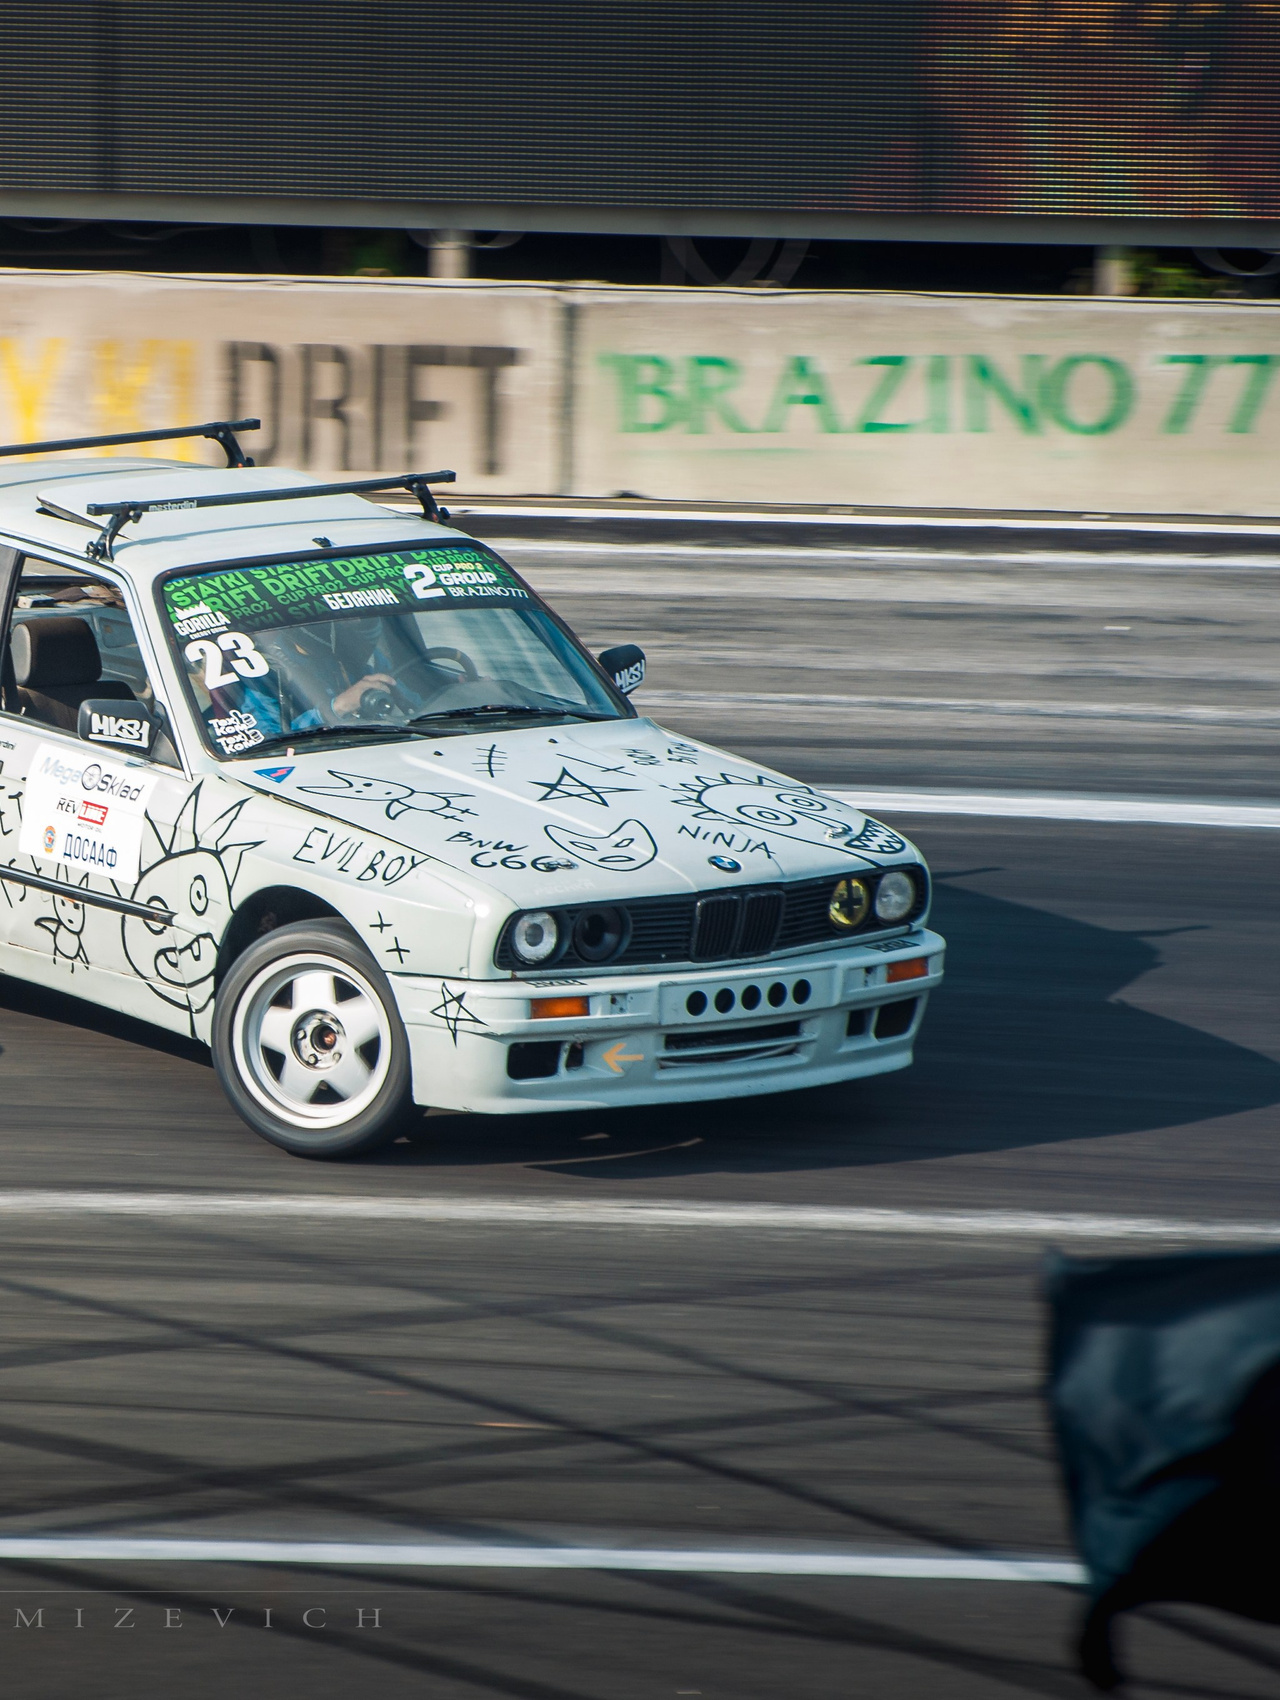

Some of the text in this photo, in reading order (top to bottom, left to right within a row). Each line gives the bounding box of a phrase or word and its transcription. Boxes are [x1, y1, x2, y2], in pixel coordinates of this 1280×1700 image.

[223, 340, 530, 476] DRIFT
[598, 353, 1140, 436] BRAZINO
[264, 564, 335, 597] DRIFT
[403, 563, 446, 599] 2
[432, 563, 453, 572] CUP
[454, 562, 475, 571] PRO
[438, 571, 498, 586] GROUP
[171, 571, 249, 607] STAYKI
[277, 588, 310, 605] CUP
[310, 579, 347, 597] PRO2
[347, 572, 377, 586] CUP
[322, 588, 400, 610] БЕЛЯНИН
[447, 586, 529, 599] BRAZINO777
[173, 610, 232, 637] GORILLA
[184, 631, 270, 690] 23
[63, 833, 118, 869] ДОСААФ
[292, 826, 433, 887] EVIL BOY
[677, 823, 776, 860] NINJA
